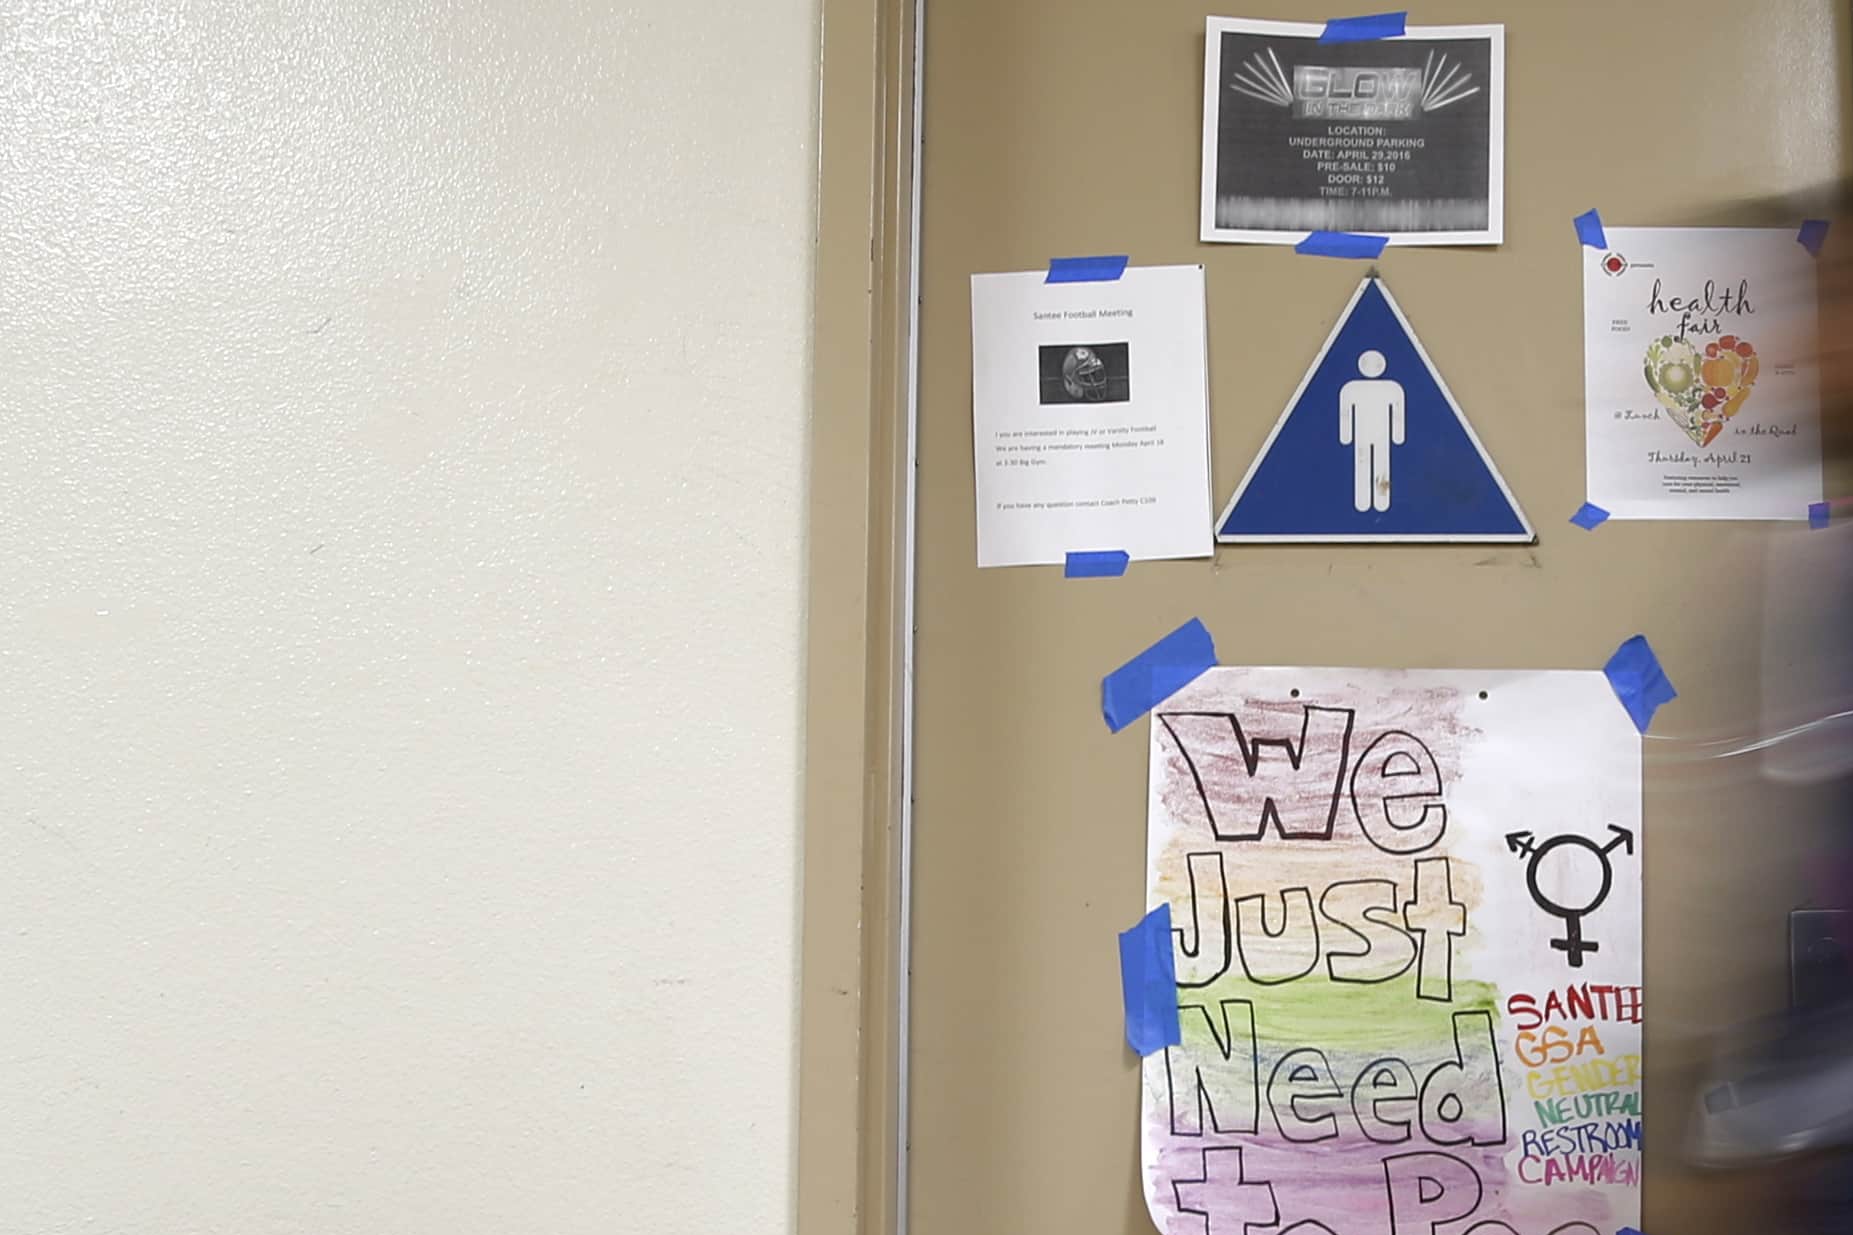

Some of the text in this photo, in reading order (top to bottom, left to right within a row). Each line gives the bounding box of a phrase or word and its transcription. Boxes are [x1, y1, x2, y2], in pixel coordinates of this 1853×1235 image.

[1288, 137, 1425, 148] UNDERGROUND PARKING
[1327, 126, 1386, 136] LOCATION:
[1302, 150, 1334, 160] DATE:
[1336, 150, 1369, 160] APRIL
[1317, 161, 1375, 172] PRE-SALE:
[1320, 186, 1348, 196] TIME:
[1327, 174, 1385, 184] DOOR: $12
[1648, 278, 1755, 315] health
[1032, 308, 1133, 321] Santee Football Meeting
[1676, 312, 1722, 342] fair
[1703, 451, 1737, 468] April
[1739, 454, 1751, 464] 21
[1157, 705, 1447, 855] We
[1170, 851, 1467, 1001] Just
[1507, 982, 1643, 1030] SANTEE
[1515, 1024, 1605, 1068] GSA
[1166, 999, 1507, 1146] Need
[1525, 1054, 1642, 1099] GENDER
[1533, 1091, 1642, 1128] NEUTRAL
[1521, 1118, 1642, 1157] RESTROOM
[1517, 1153, 1640, 1186] CAMPAIGN
